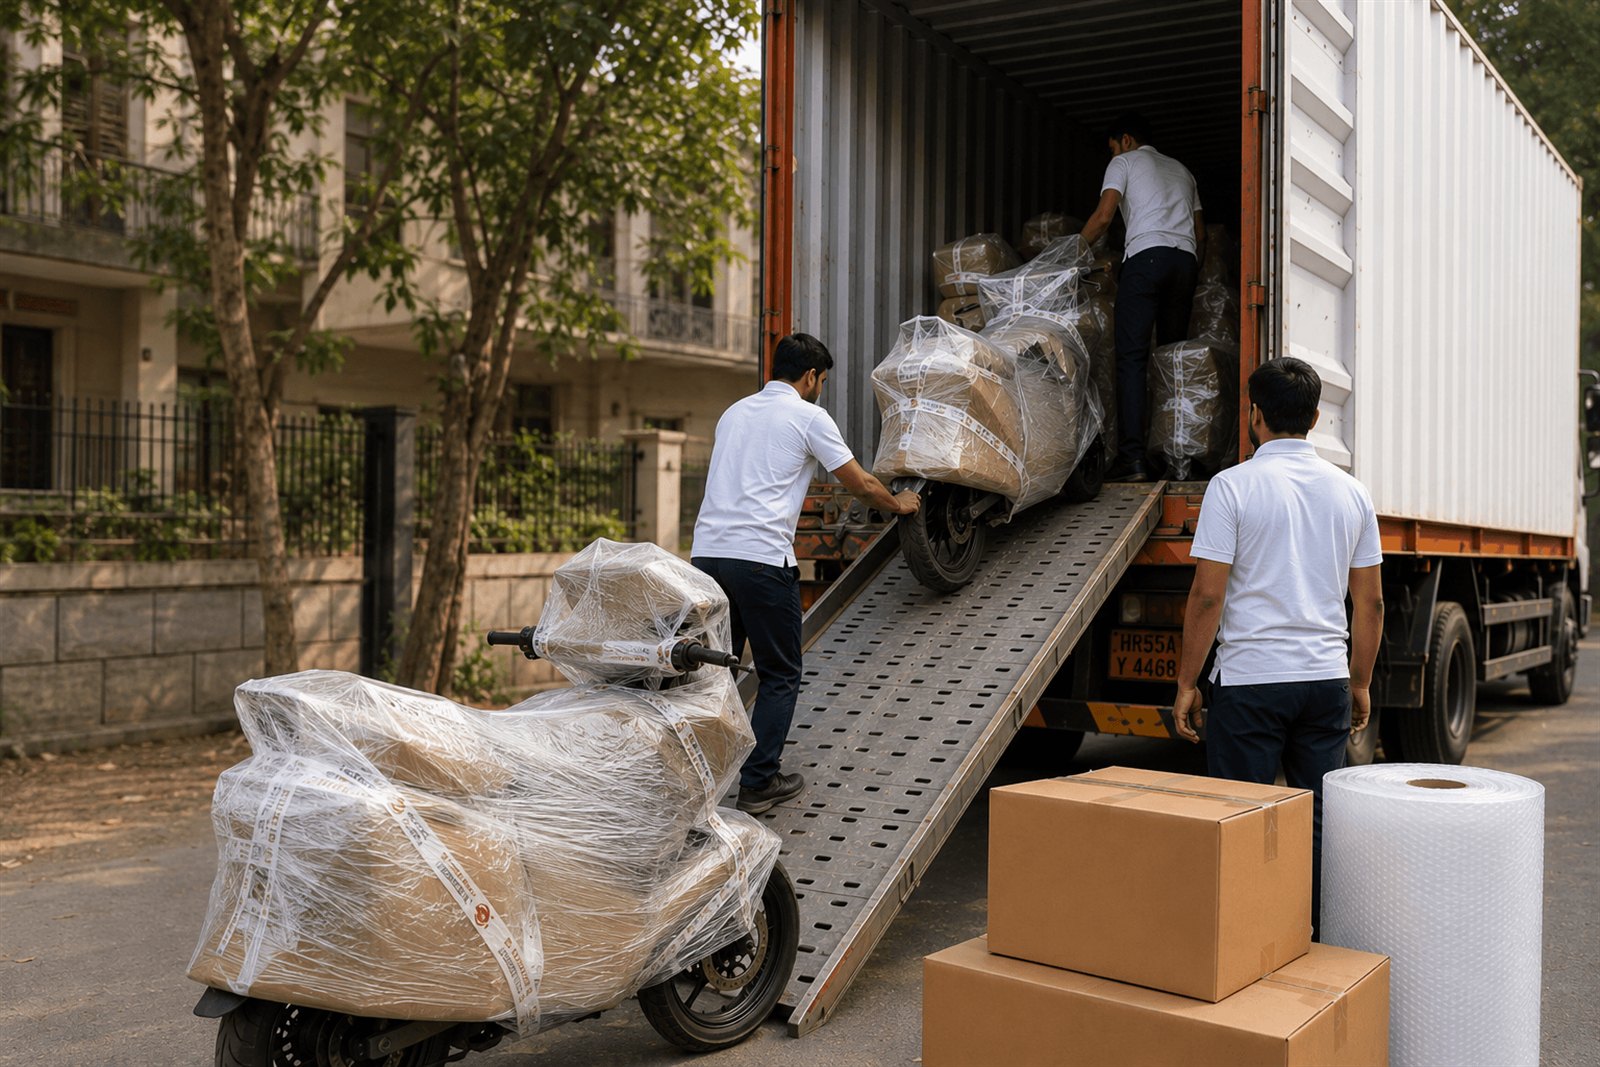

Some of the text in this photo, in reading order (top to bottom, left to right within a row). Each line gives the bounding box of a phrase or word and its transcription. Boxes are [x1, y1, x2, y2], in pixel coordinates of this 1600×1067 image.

[1120, 634, 1176, 654] HR55A
[1117, 657, 1176, 677] Y 4468
